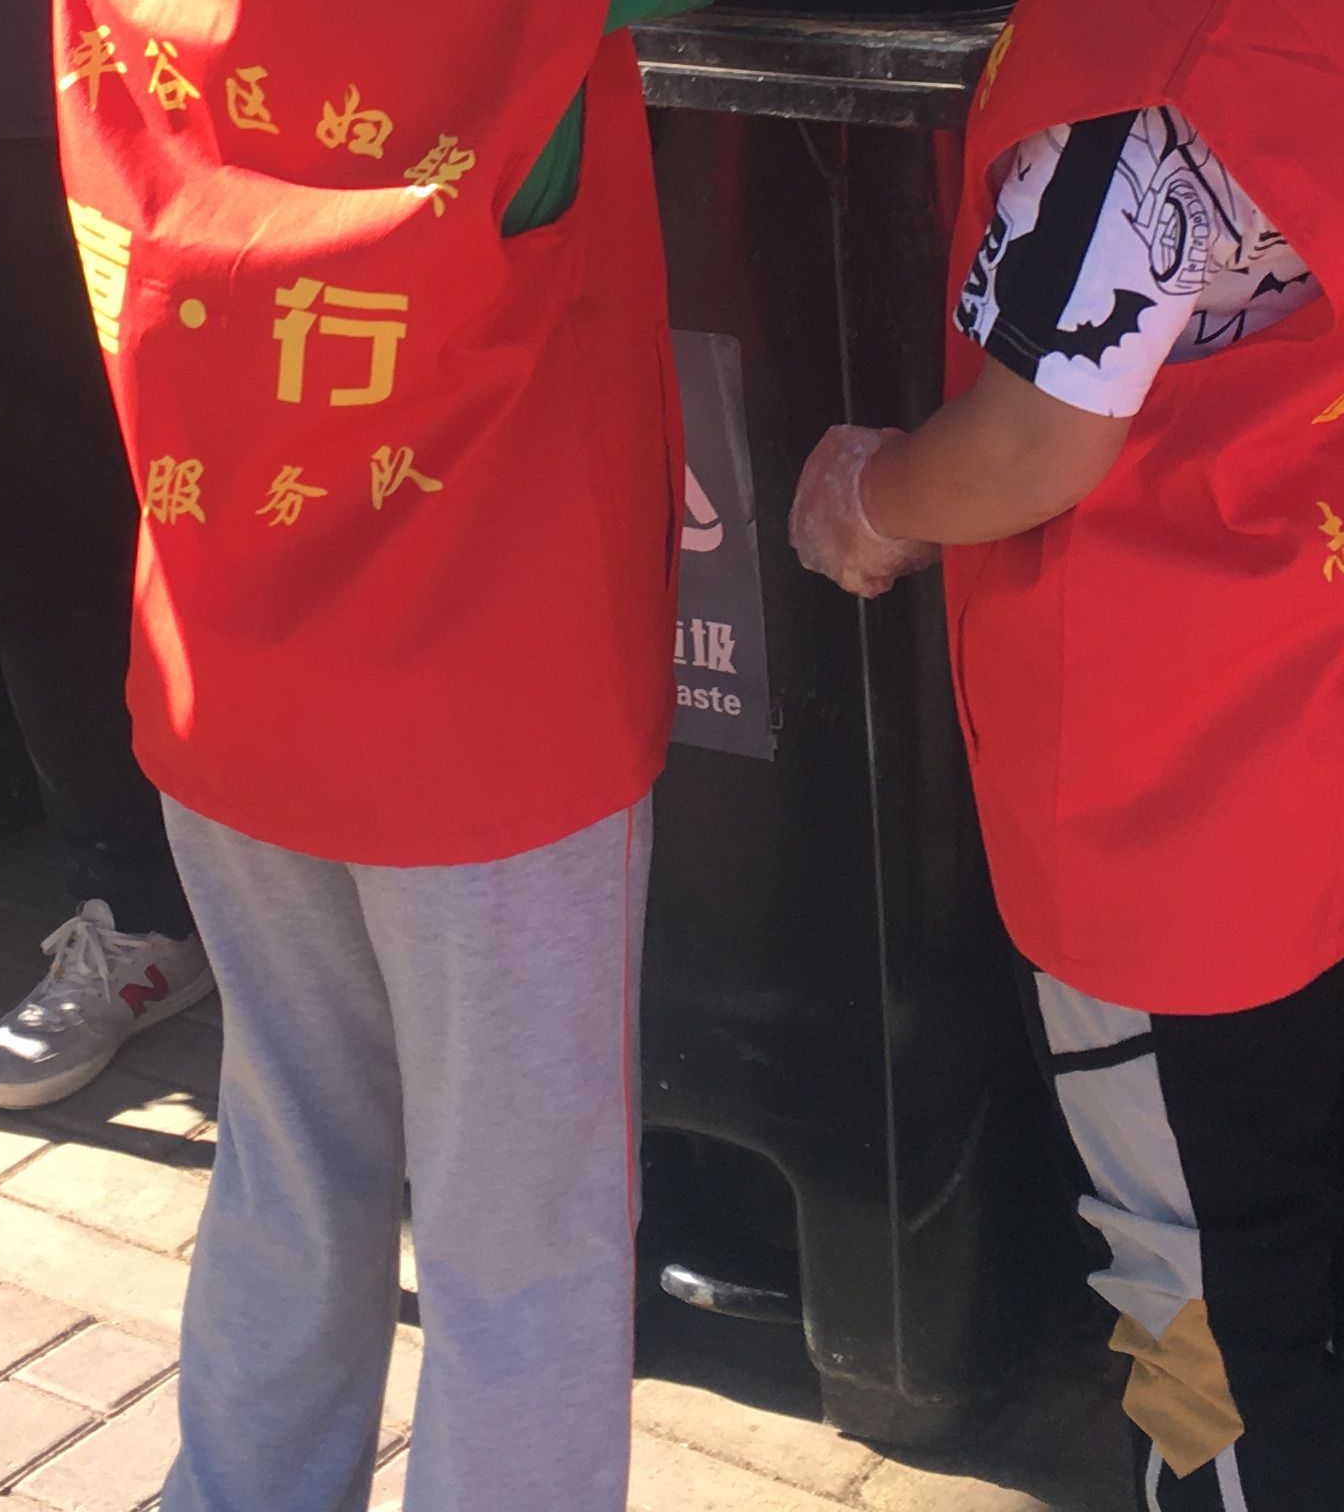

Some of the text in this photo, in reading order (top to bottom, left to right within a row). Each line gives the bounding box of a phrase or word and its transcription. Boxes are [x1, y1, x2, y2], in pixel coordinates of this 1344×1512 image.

[141, 446, 444, 527] 服务队
[674, 684, 742, 716] aste
